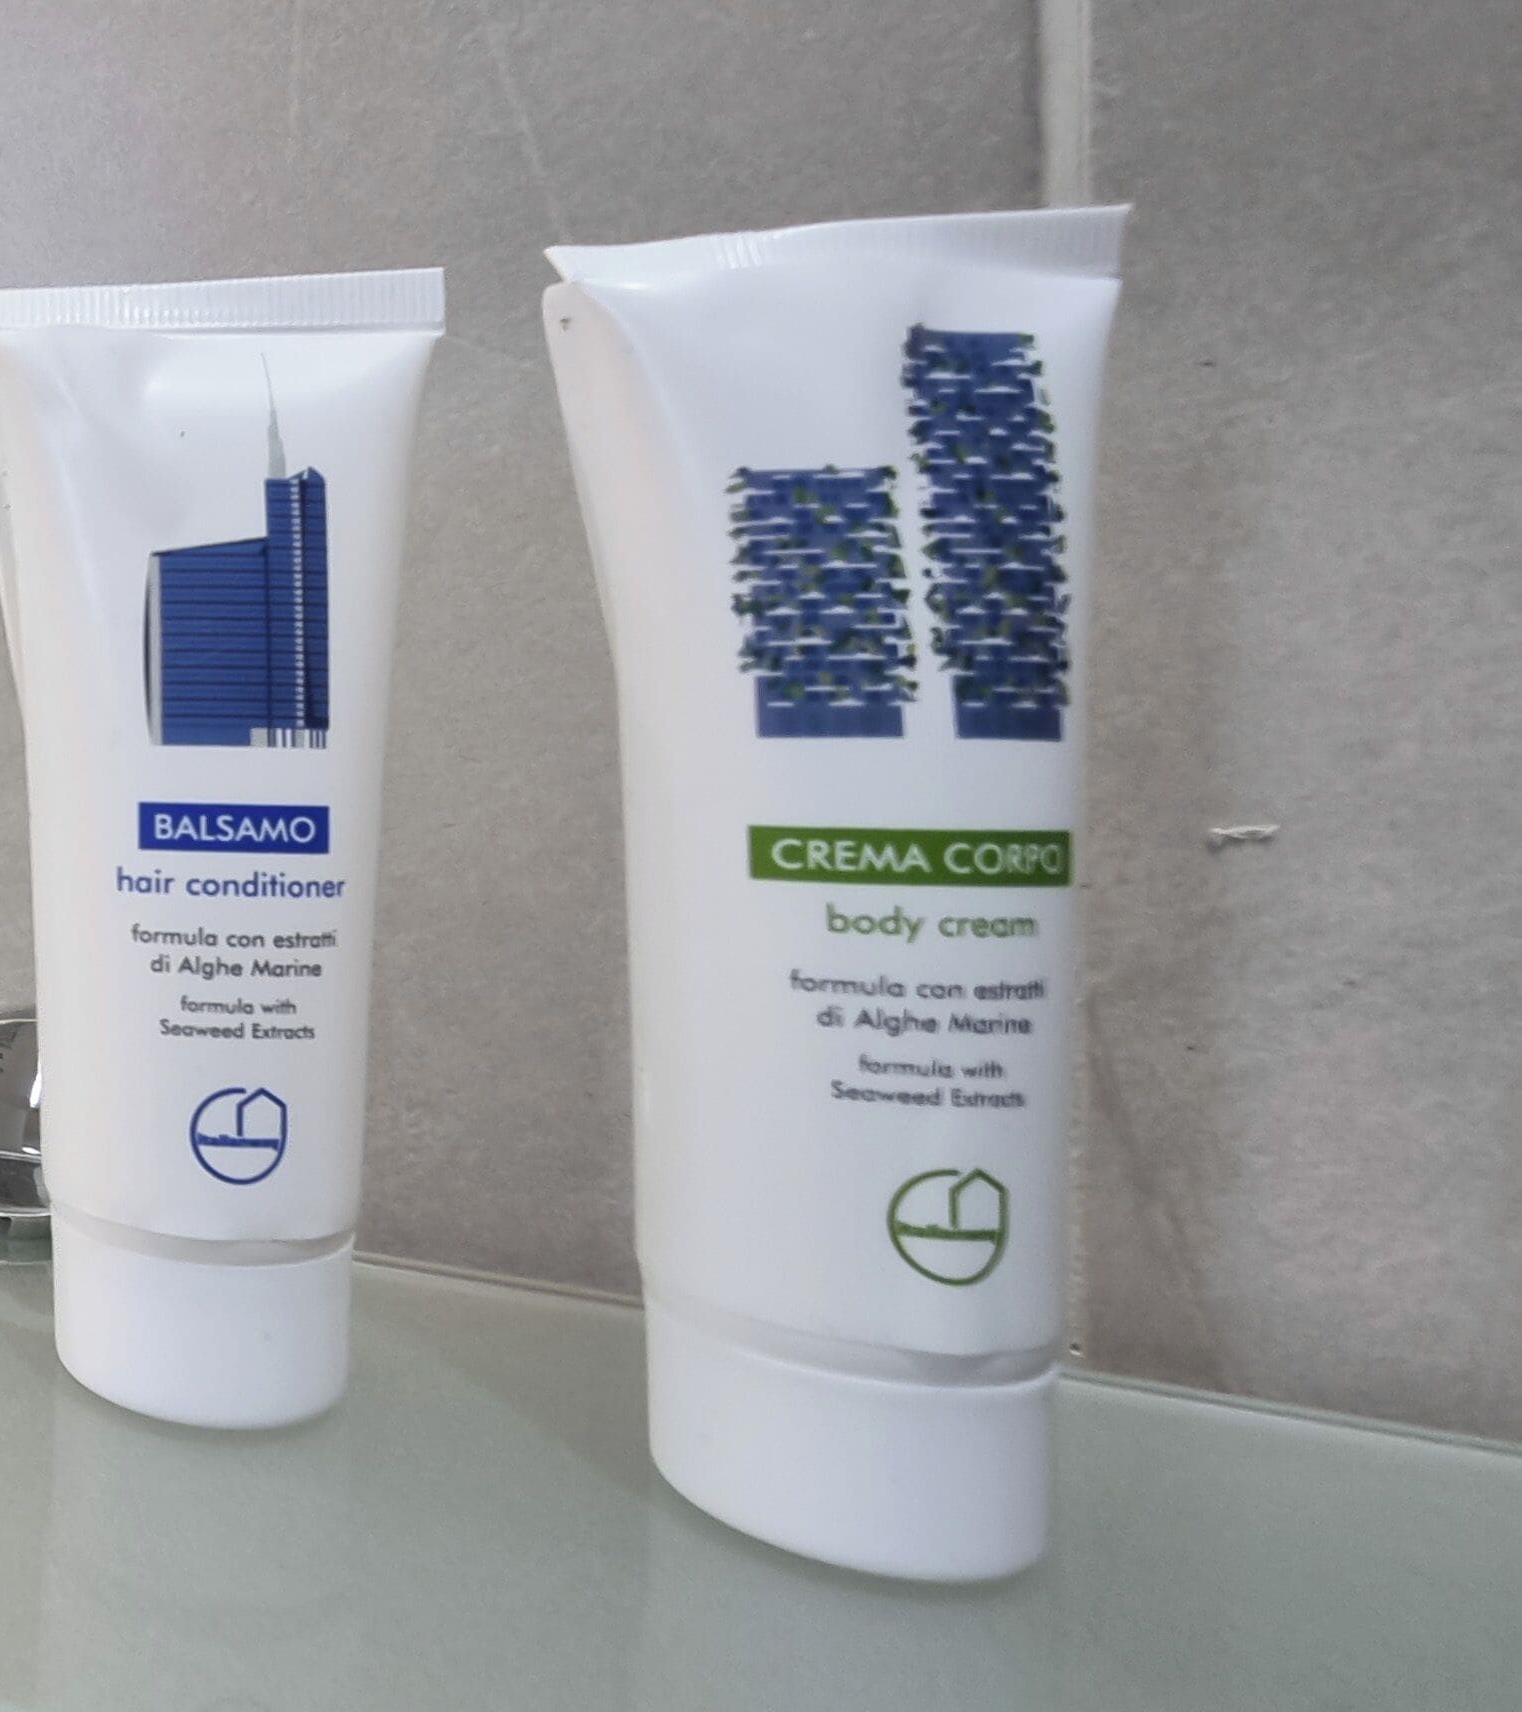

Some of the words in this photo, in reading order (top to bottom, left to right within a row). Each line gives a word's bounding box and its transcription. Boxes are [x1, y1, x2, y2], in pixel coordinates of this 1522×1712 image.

[153, 813, 316, 843] BALSAMO
[772, 838, 932, 874] CREMA
[944, 842, 1064, 875] CORPO
[116, 866, 175, 895] hair
[186, 871, 345, 898] conditioner
[131, 924, 218, 948] formula
[226, 932, 265, 948] con
[273, 929, 338, 949] estratti
[826, 902, 924, 943] body
[938, 914, 1039, 938] cream
[150, 954, 170, 974] di
[178, 957, 243, 980] Alghe
[250, 958, 322, 978] Marine
[789, 968, 906, 998] formula
[916, 982, 965, 999] con
[180, 995, 254, 1015] formula
[260, 998, 297, 1015] with
[159, 1019, 244, 1039] Seaweed
[252, 1023, 315, 1041] Extracts
[816, 1005, 844, 1028] di
[854, 1008, 939, 1037] Alghe
[948, 1011, 1033, 1035] Marine
[858, 1054, 954, 1079] formula
[961, 1059, 1005, 1079] with
[831, 1079, 942, 1106] Seaweed
